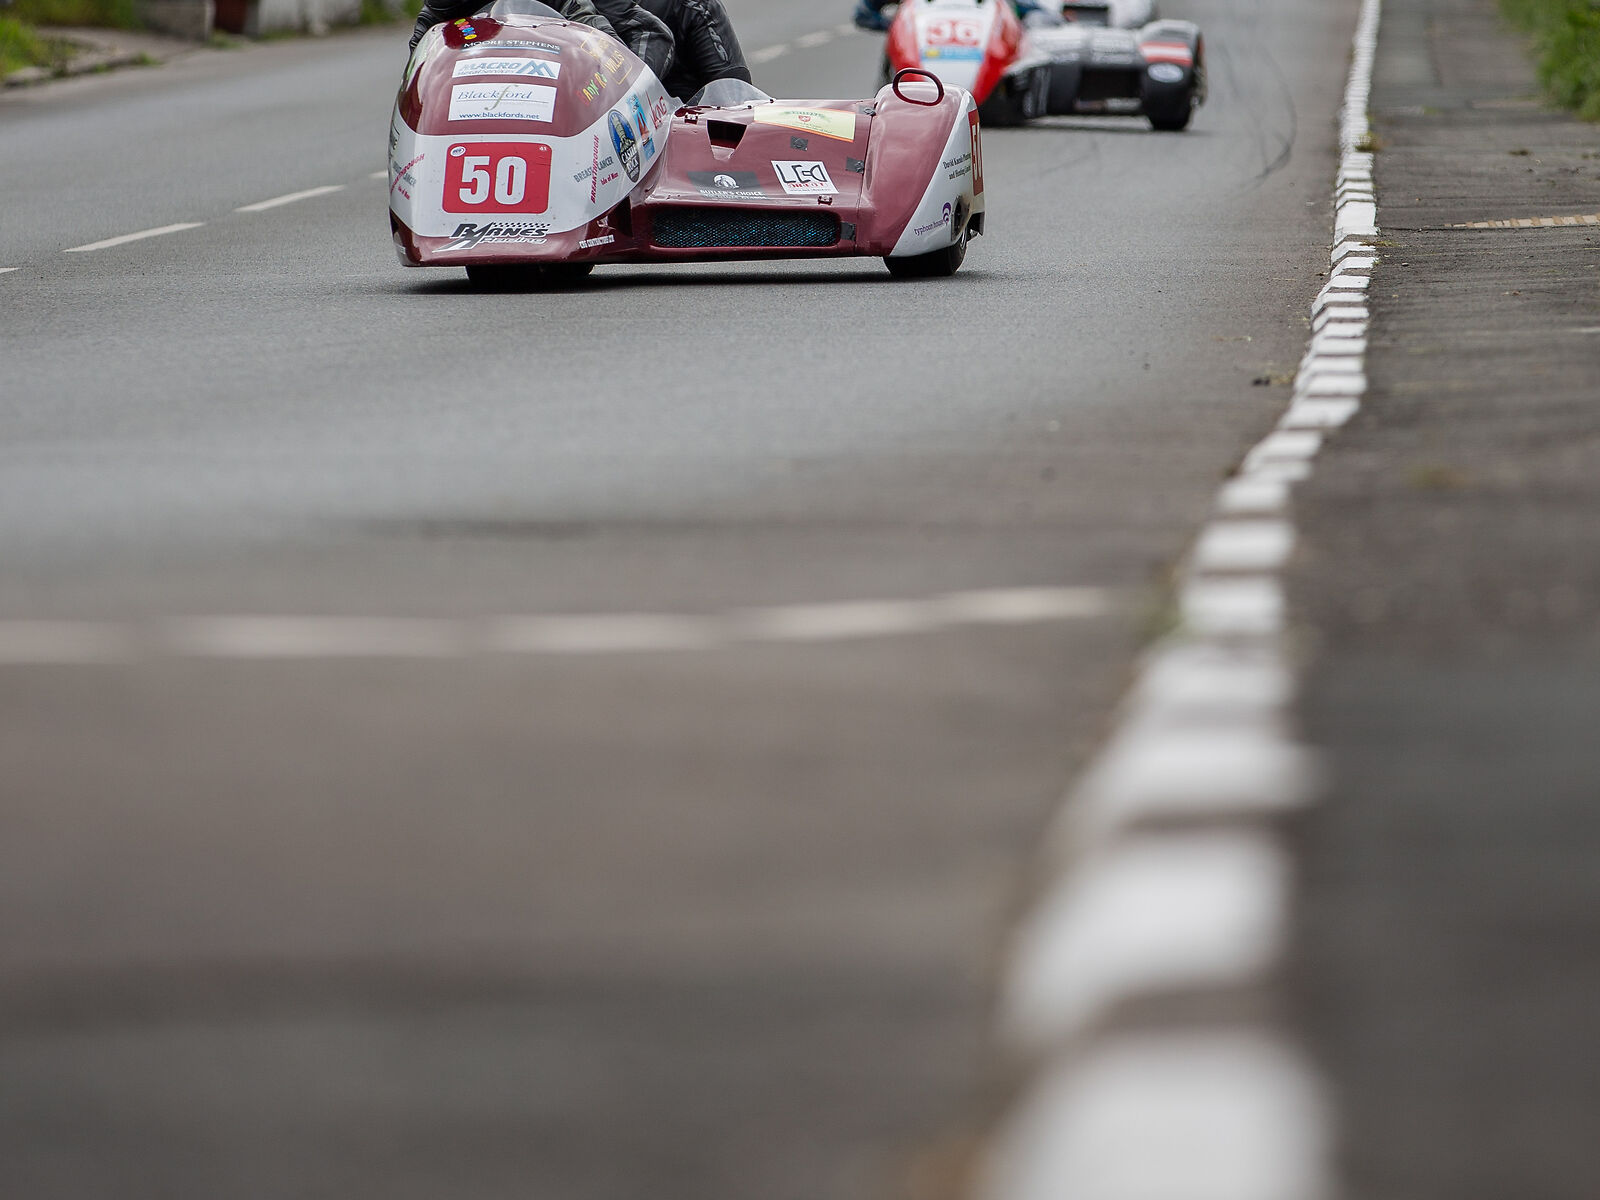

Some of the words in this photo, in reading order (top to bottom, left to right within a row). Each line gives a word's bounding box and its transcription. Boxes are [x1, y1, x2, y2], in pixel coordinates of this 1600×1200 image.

[463, 40, 502, 48] MOORE
[506, 40, 560, 51] STEPHENS
[460, 62, 521, 70] MACRO
[458, 84, 533, 111] Blackford
[459, 112, 541, 120] www.blackfords.net
[590, 135, 600, 204] BREAKTHROUGH
[459, 156, 527, 205] 50
